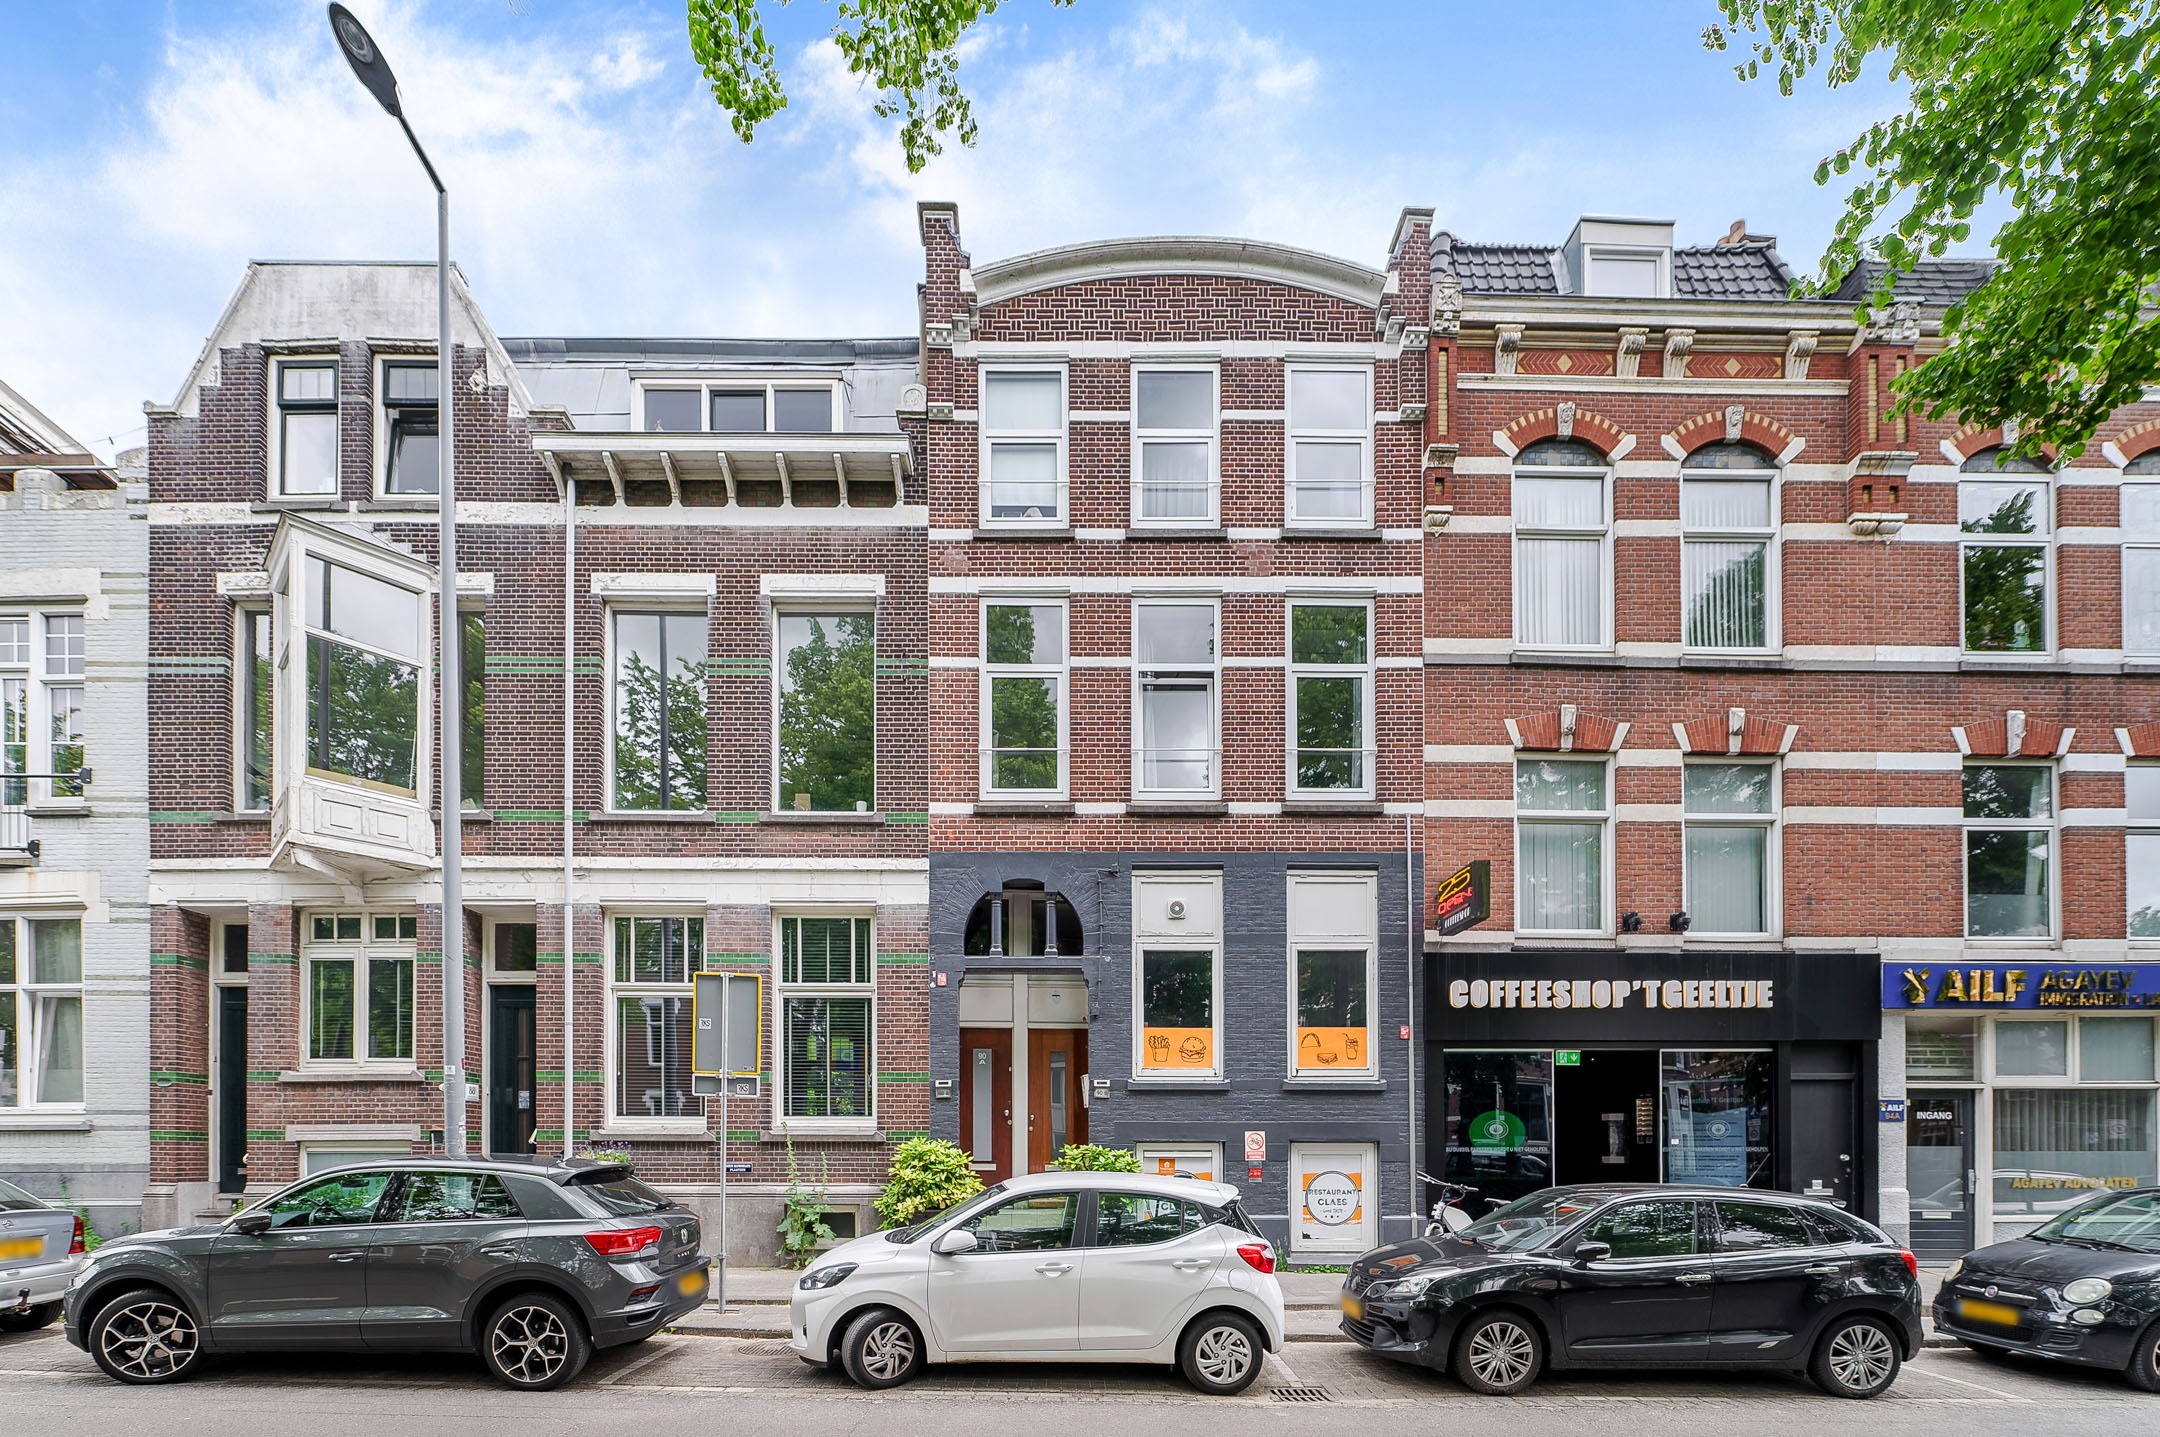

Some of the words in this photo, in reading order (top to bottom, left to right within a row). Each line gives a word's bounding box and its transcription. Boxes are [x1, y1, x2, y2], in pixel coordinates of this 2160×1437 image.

[1438, 866, 1472, 903] 25
[1438, 886, 1473, 915] OPEN
[2040, 969, 2137, 990] AGAYEV
[1936, 969, 2028, 1002] AILF
[977, 1052, 987, 1060] 90
[1886, 1104, 1904, 1112] AILF
[1916, 1111, 1953, 1120] INGANG
[2063, 1176, 2138, 1189] ADVOCATEN
[1308, 1188, 1357, 1196] RESTAURANT
[1317, 1198, 1348, 1206] CLAES
